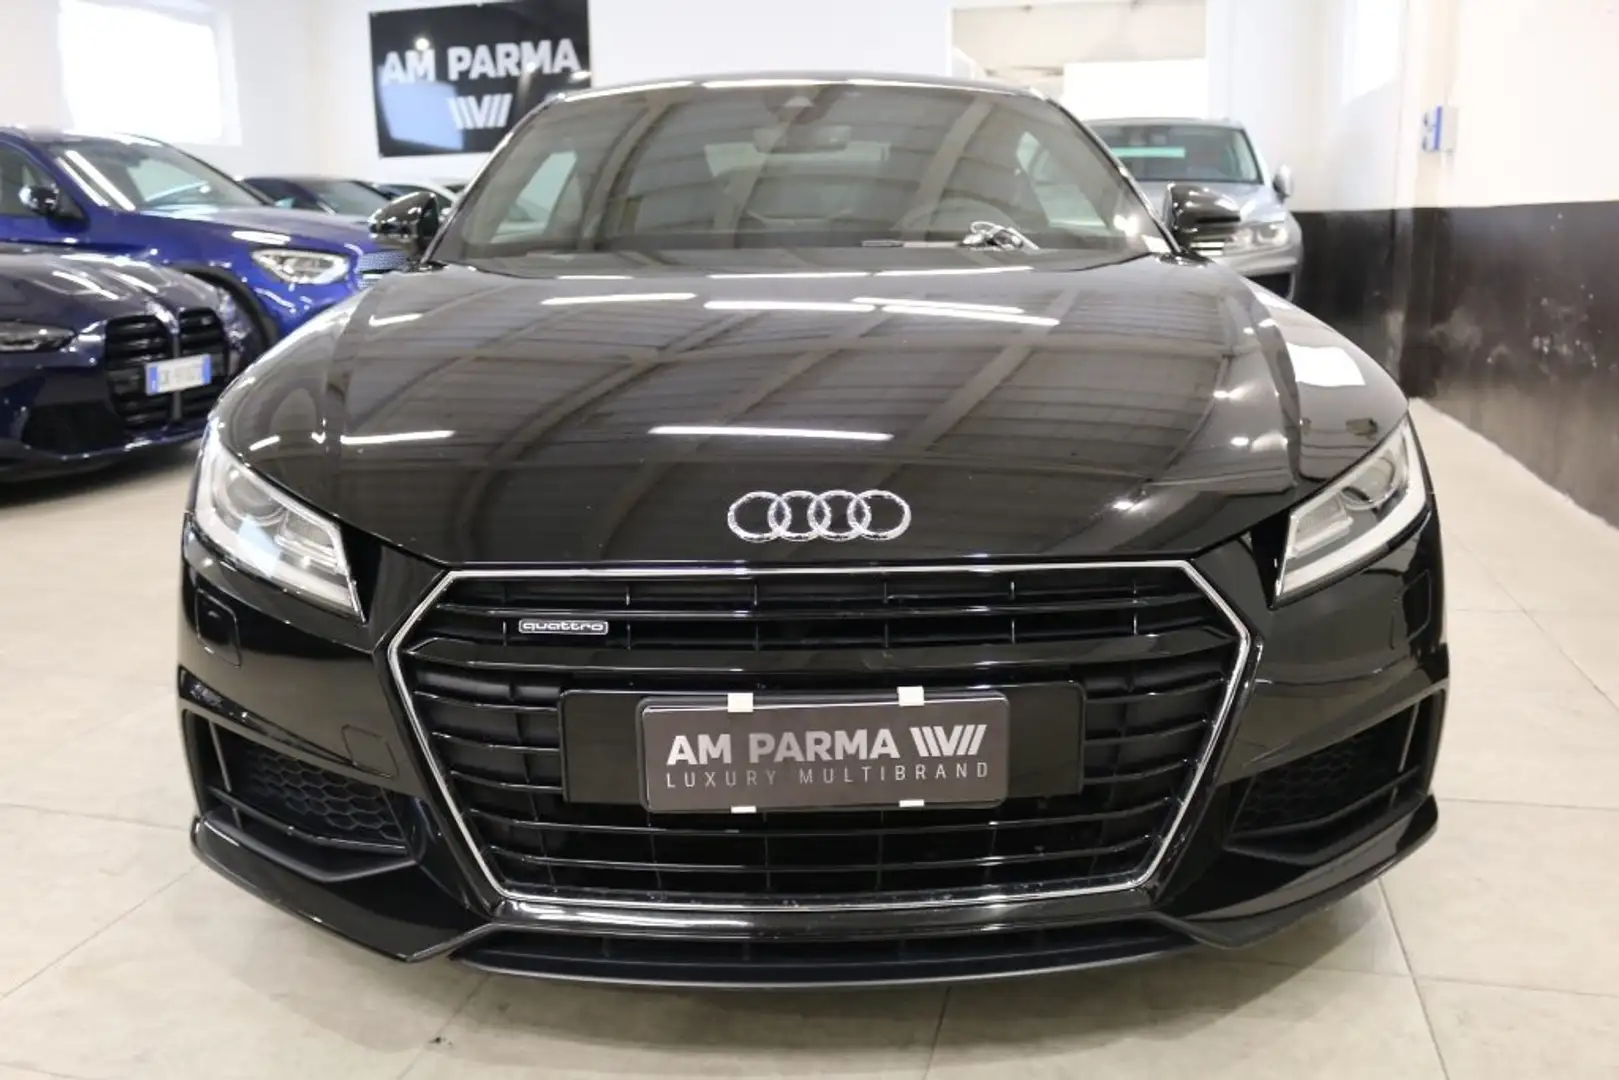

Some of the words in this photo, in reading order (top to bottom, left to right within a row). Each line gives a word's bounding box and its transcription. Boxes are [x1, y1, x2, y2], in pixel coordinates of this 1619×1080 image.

[384, 50, 436, 84] AM
[447, 38, 580, 81] PARMA
[522, 621, 604, 632] quattro
[667, 734, 732, 765] AM
[749, 728, 899, 764] PARMA
[667, 770, 776, 788] LUXURY
[799, 762, 987, 785] MULTIBRAND
